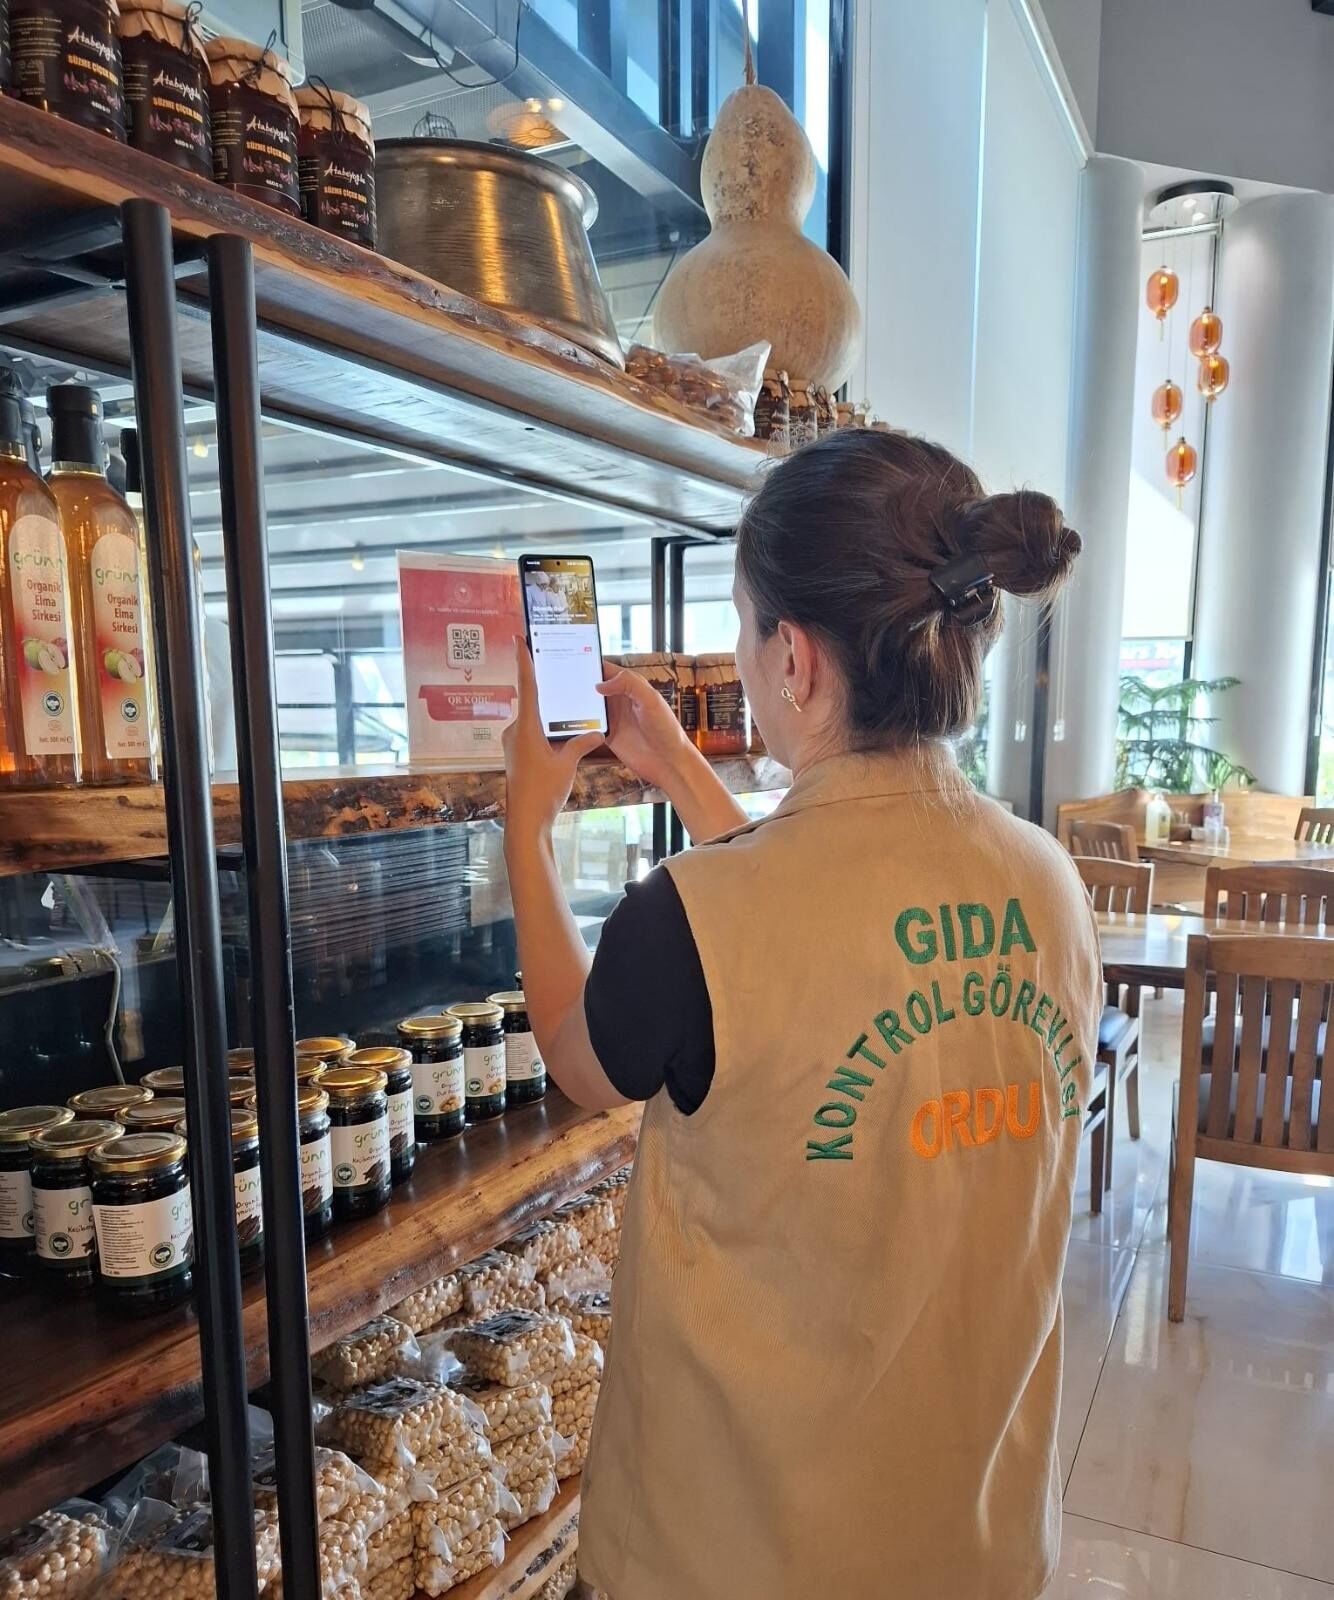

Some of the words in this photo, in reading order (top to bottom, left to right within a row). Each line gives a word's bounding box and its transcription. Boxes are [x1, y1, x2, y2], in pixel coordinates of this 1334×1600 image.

[26, 579, 62, 593] Organik
[35, 595, 57, 607] Elma
[107, 593, 139, 607] Organik
[32, 609, 61, 622] Sirkesi
[114, 607, 134, 620] Elma
[112, 623, 139, 634] Sirkesi
[447, 695, 462, 706] QR
[893, 897, 1038, 965] GIDA
[805, 979, 956, 1161] KONTROL
[909, 1080, 1042, 1160] ORDU
